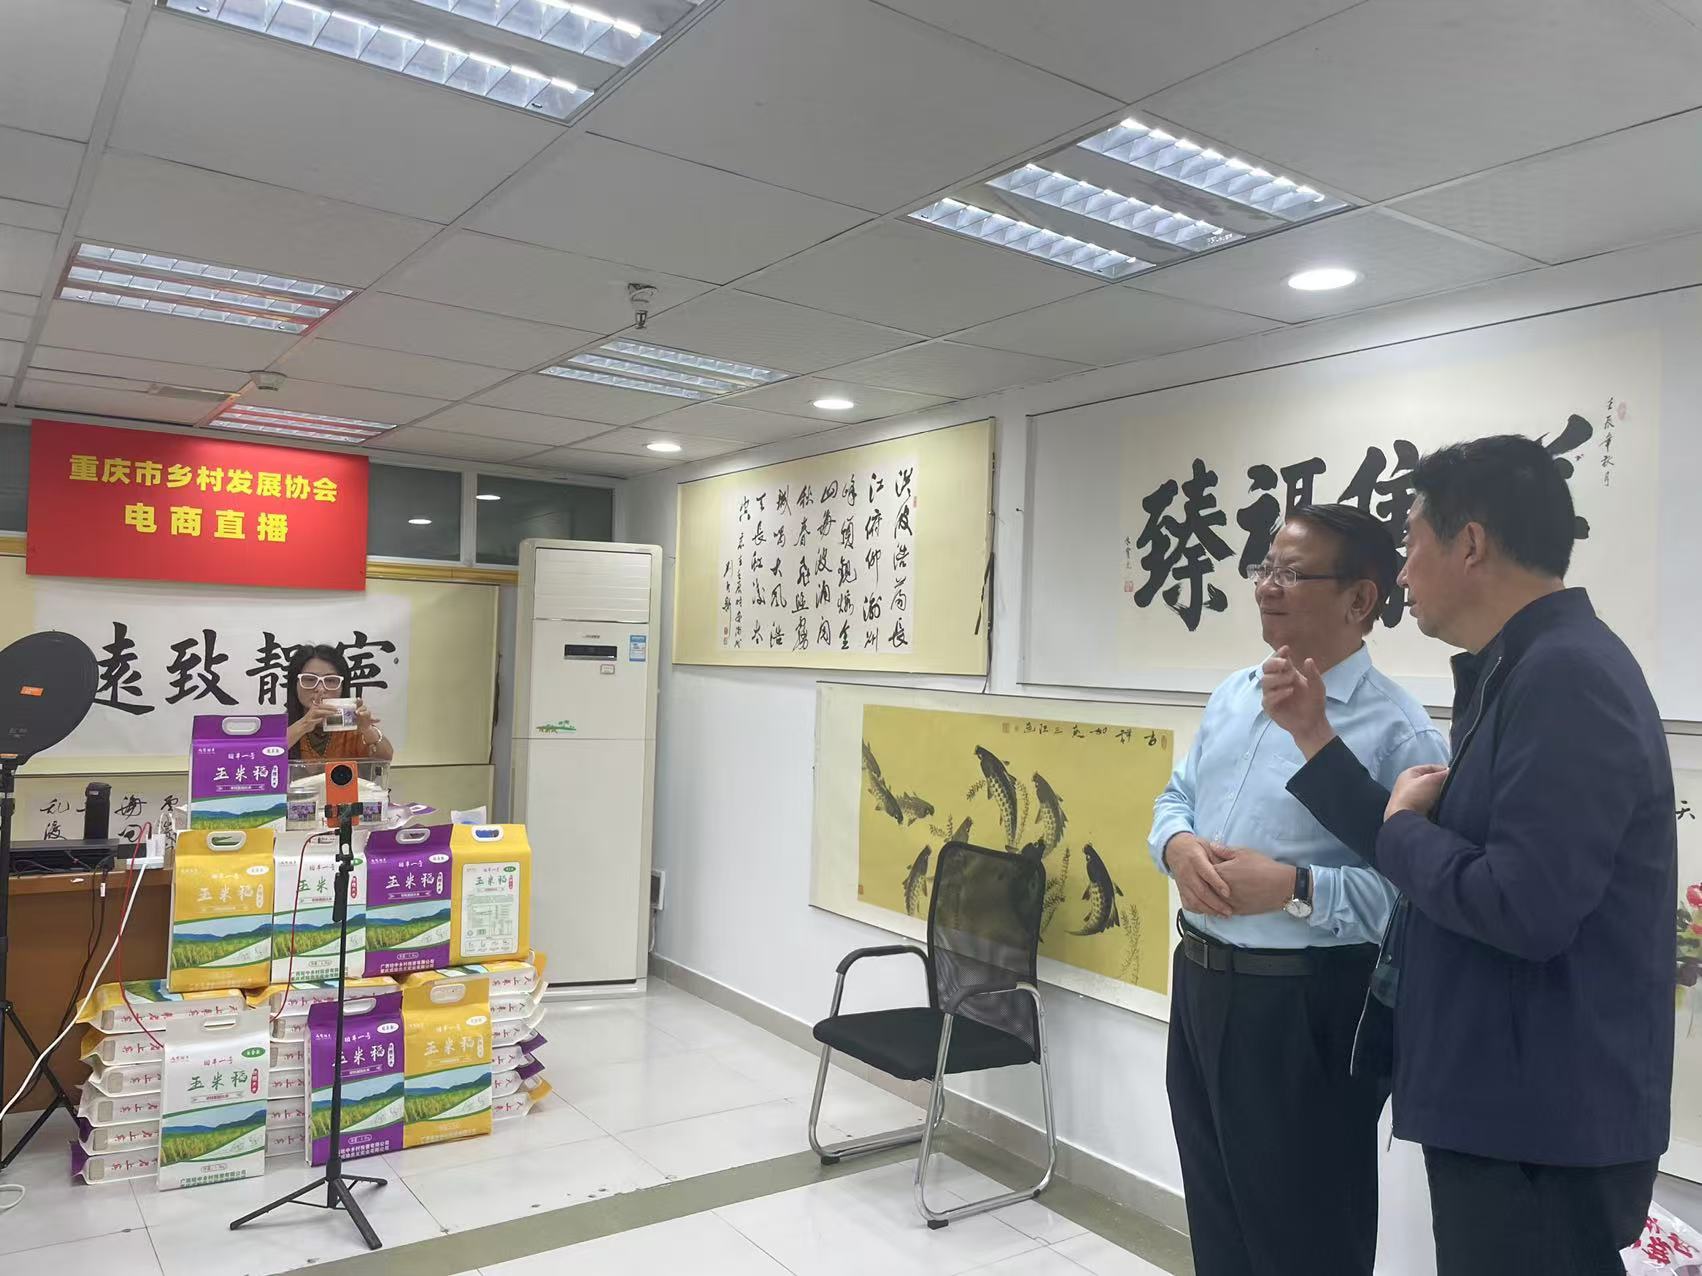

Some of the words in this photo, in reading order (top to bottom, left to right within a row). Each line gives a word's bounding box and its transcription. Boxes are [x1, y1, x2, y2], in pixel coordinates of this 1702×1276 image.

[69, 454, 338, 503] 重庆市乡村发展协会
[125, 503, 289, 543] 电商直播
